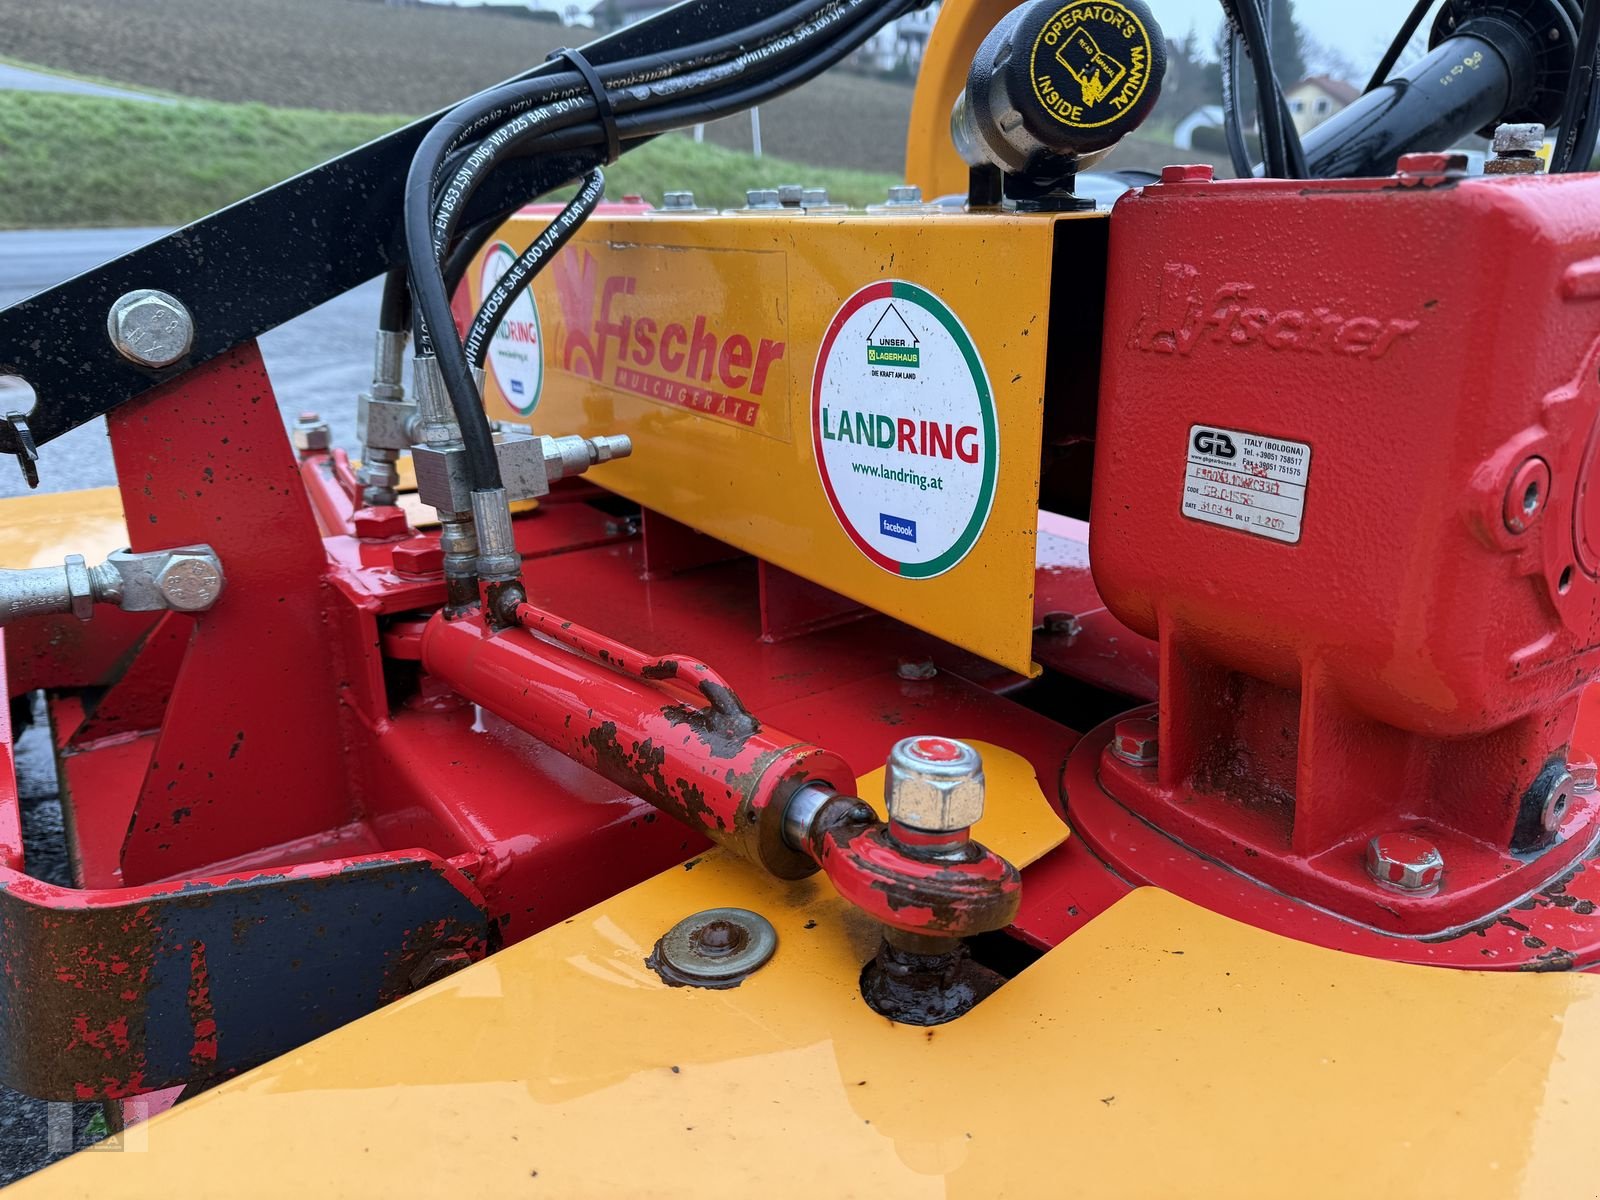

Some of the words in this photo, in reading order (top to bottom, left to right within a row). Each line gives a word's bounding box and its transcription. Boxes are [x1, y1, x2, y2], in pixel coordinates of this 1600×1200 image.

[1045, 6, 1136, 45] OPERATOR'S
[1109, 46, 1144, 110] MANUAL
[1038, 76, 1083, 120] INSIDE
[510, 115, 529, 134] 225
[527, 108, 551, 126] BAR
[454, 168, 473, 190] 1SN
[442, 187, 460, 211] 853
[435, 209, 451, 230] EN
[465, 285, 508, 370] WHITE-HOSE
[503, 262, 526, 290] SAE
[521, 244, 544, 270] 100
[561, 201, 585, 228] R1AT
[879, 338, 906, 347] UNSER
[875, 352, 918, 363] LAGERHAUS
[880, 370, 895, 379] KRAFT
[903, 372, 917, 380] LAND
[822, 407, 980, 464] LANDRING
[1194, 431, 1237, 459] GB
[1243, 448, 1255, 457] Tel.
[1256, 450, 1279, 462] +39051
[1280, 455, 1303, 466] 758517
[1244, 438, 1263, 448] ITALY
[1264, 440, 1304, 457] (BOLOGNA)
[1242, 458, 1254, 467] Fax
[851, 461, 944, 491] www.landring.at
[1186, 486, 1200, 495] CODE
[1184, 501, 1197, 510] DATE
[883, 520, 914, 537] facebook
